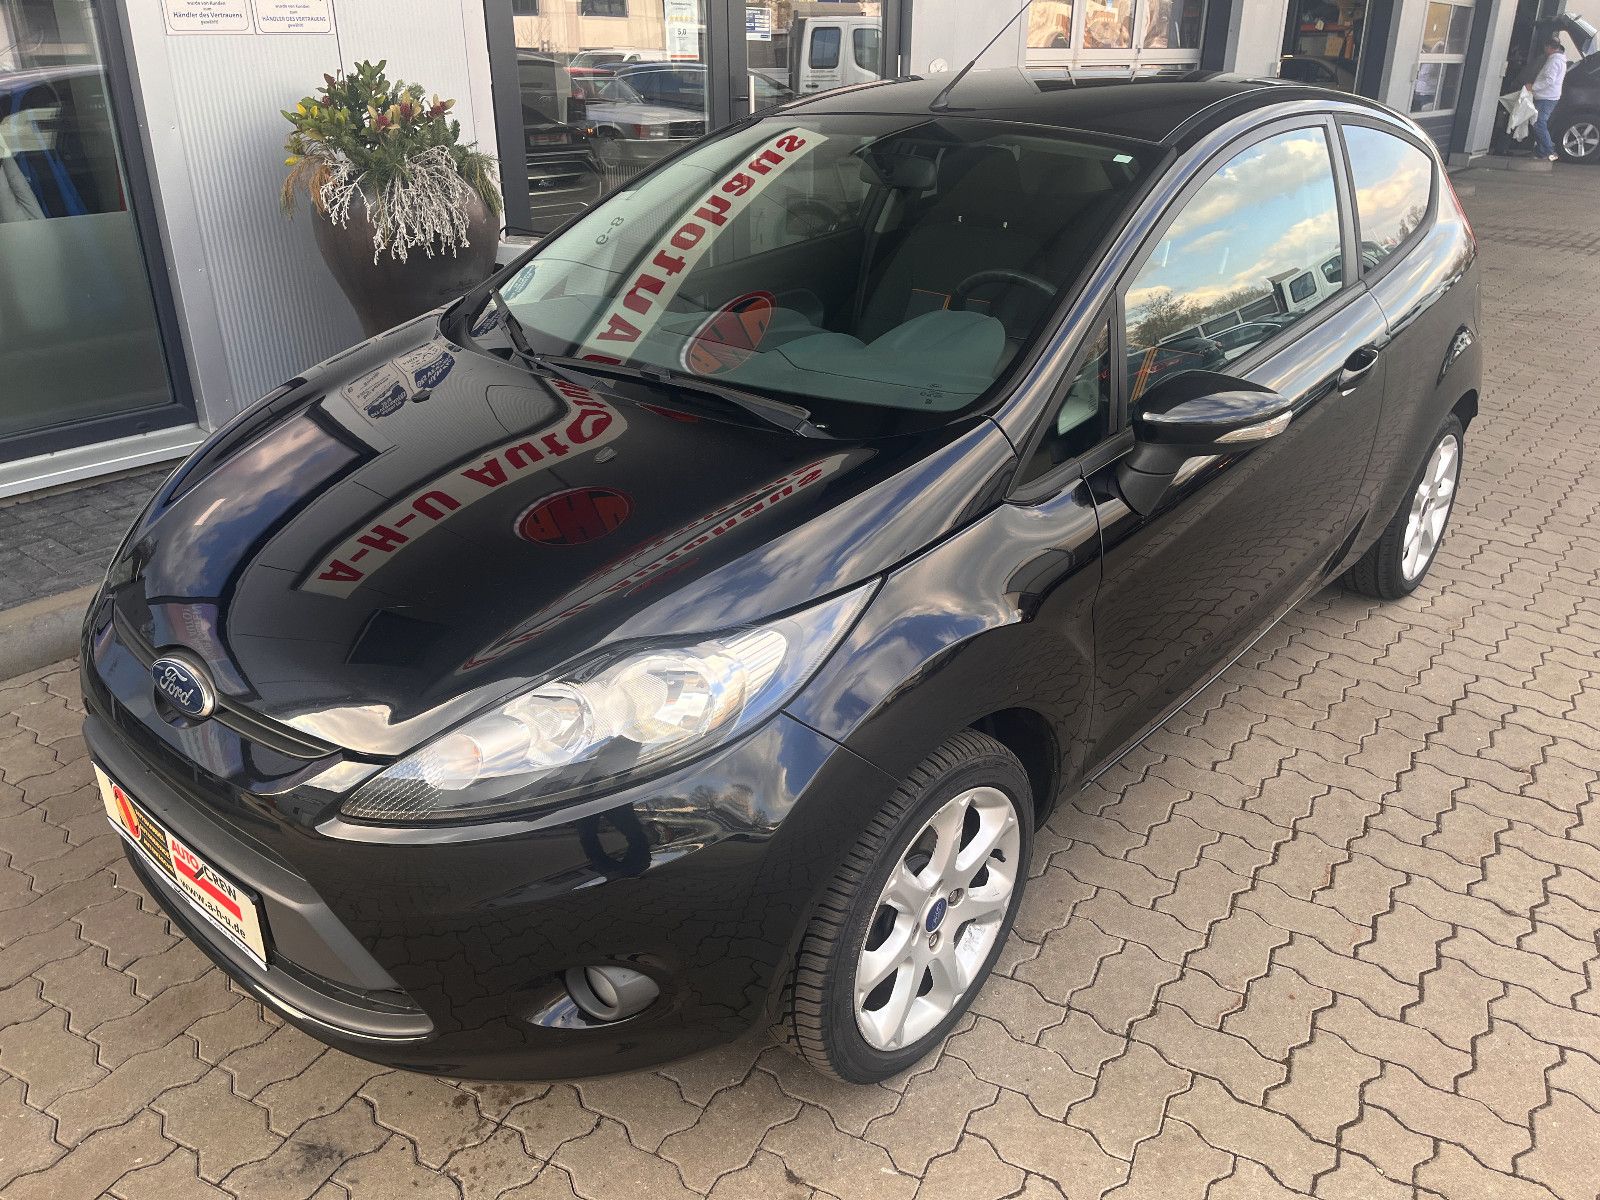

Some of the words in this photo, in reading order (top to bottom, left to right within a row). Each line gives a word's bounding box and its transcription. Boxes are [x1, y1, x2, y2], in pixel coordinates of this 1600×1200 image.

[210, 11, 243, 19] Vertrauens
[159, 666, 195, 706] Ford
[171, 839, 199, 870] AUTO
[203, 866, 237, 901] CREW
[180, 879, 246, 939] www.a-h-u.de
